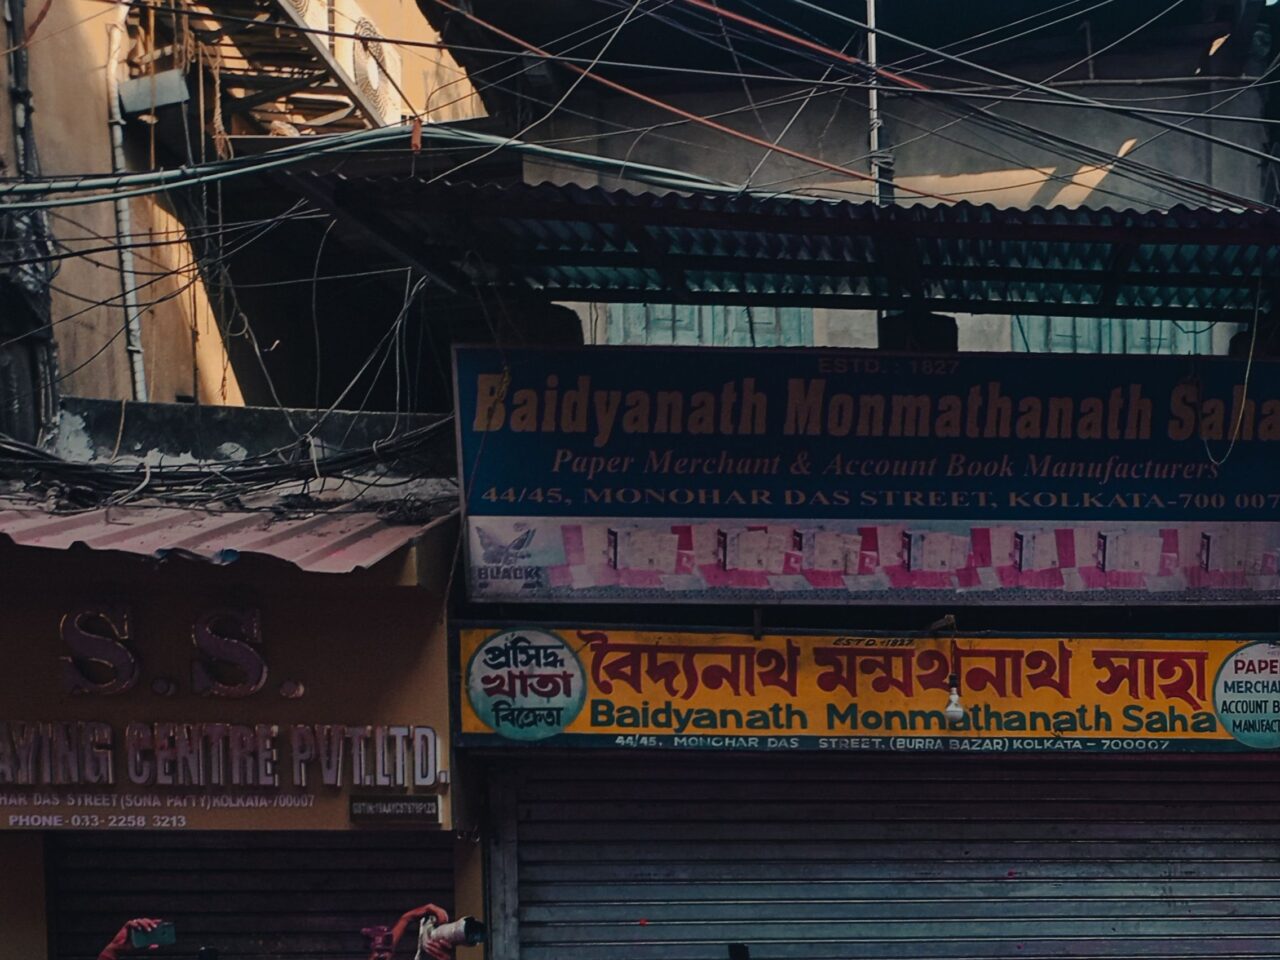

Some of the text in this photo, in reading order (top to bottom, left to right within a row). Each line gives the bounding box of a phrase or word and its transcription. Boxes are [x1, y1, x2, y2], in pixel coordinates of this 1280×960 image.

[472, 373, 768, 448] Baidyanath
[783, 377, 1153, 440] Monmathanath
[552, 448, 1220, 485] Paper Merchant & Account Book Manufacturers
[480, 486, 573, 506] 44/45,
[584, 487, 774, 506] MONOHAR
[784, 488, 851, 507] DAS
[859, 489, 998, 509] STREET,
[1234, 493, 1280, 509] 007
[577, 630, 801, 700] বৈদ্যনাথ
[1091, 649, 1209, 711] সাহা
[481, 671, 575, 702] খাতা
[590, 699, 1217, 734] Baidyanath Monmathanath Saha
[1220, 700, 1269, 714] ACCOUNT
[125, 722, 280, 788] CENTRE
[673, 736, 760, 749] MONOHAR
[767, 737, 800, 749] DAS
[889, 736, 944, 751] (BURRA
[949, 738, 1009, 752] BAZAR)
[1012, 739, 1083, 750] KOLKATA
[1101, 739, 1170, 751] 700007
[33, 793, 60, 806] DAS
[152, 815, 187, 828] 3213
